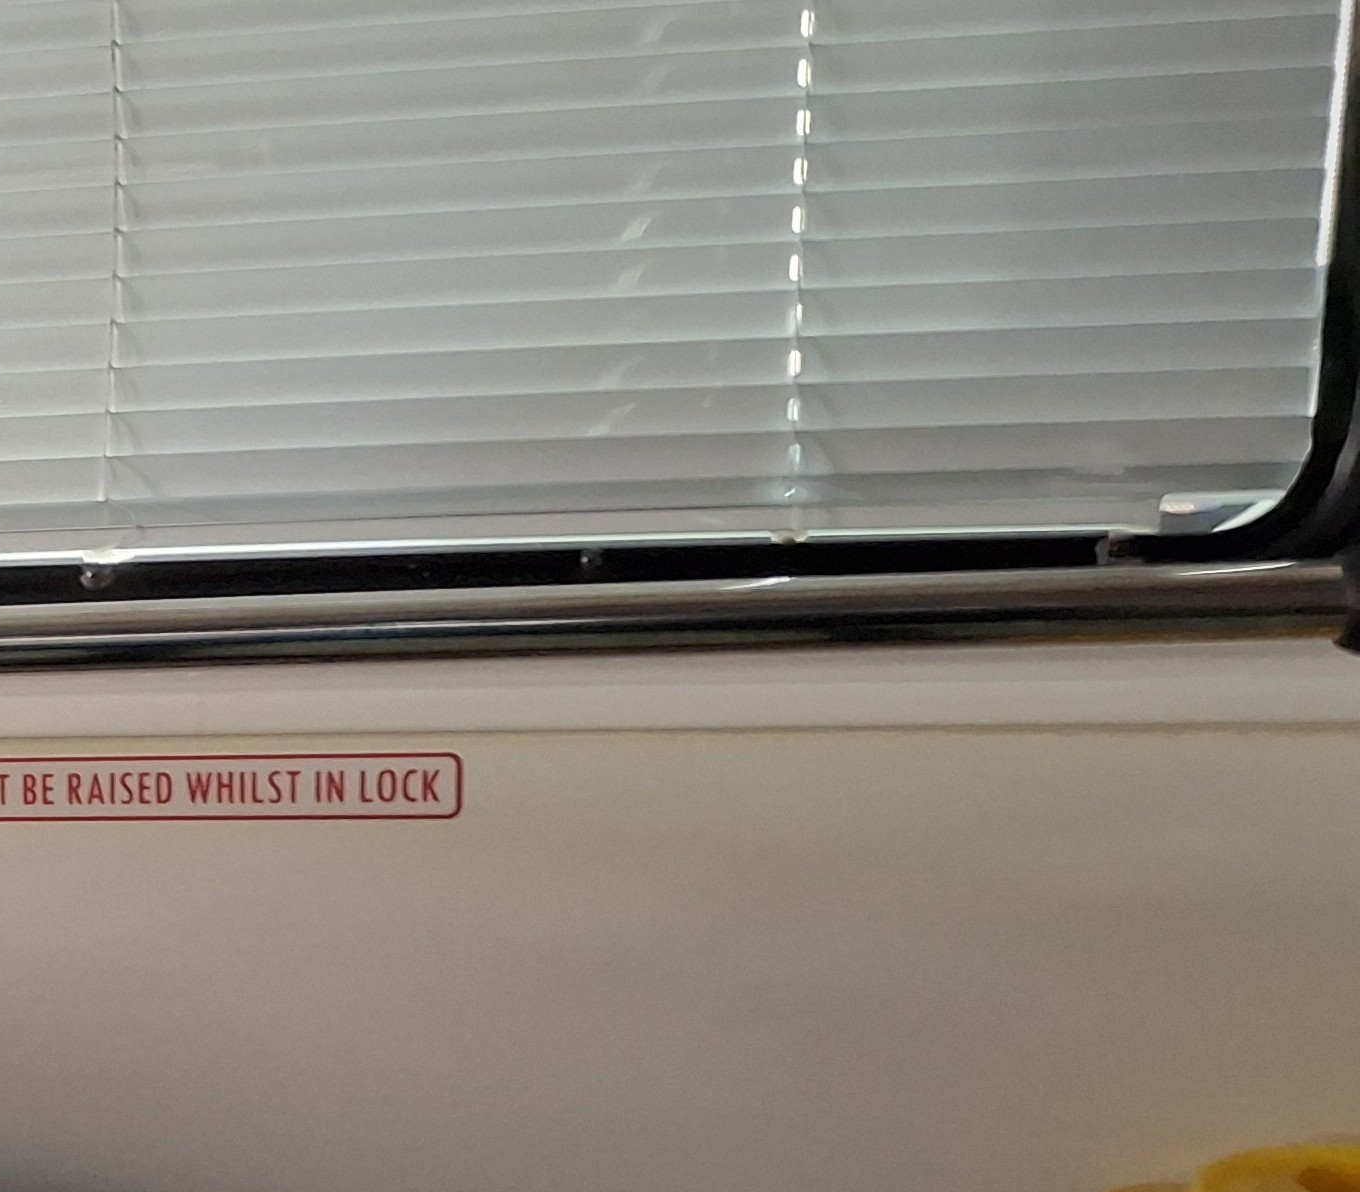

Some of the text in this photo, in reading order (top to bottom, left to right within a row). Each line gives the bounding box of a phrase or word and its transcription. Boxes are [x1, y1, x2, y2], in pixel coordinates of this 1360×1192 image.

[23, 773, 55, 806] BE
[67, 772, 173, 805] RAISED
[186, 770, 301, 804] WHILST
[315, 770, 345, 803] IN
[360, 769, 441, 803] LOCK
